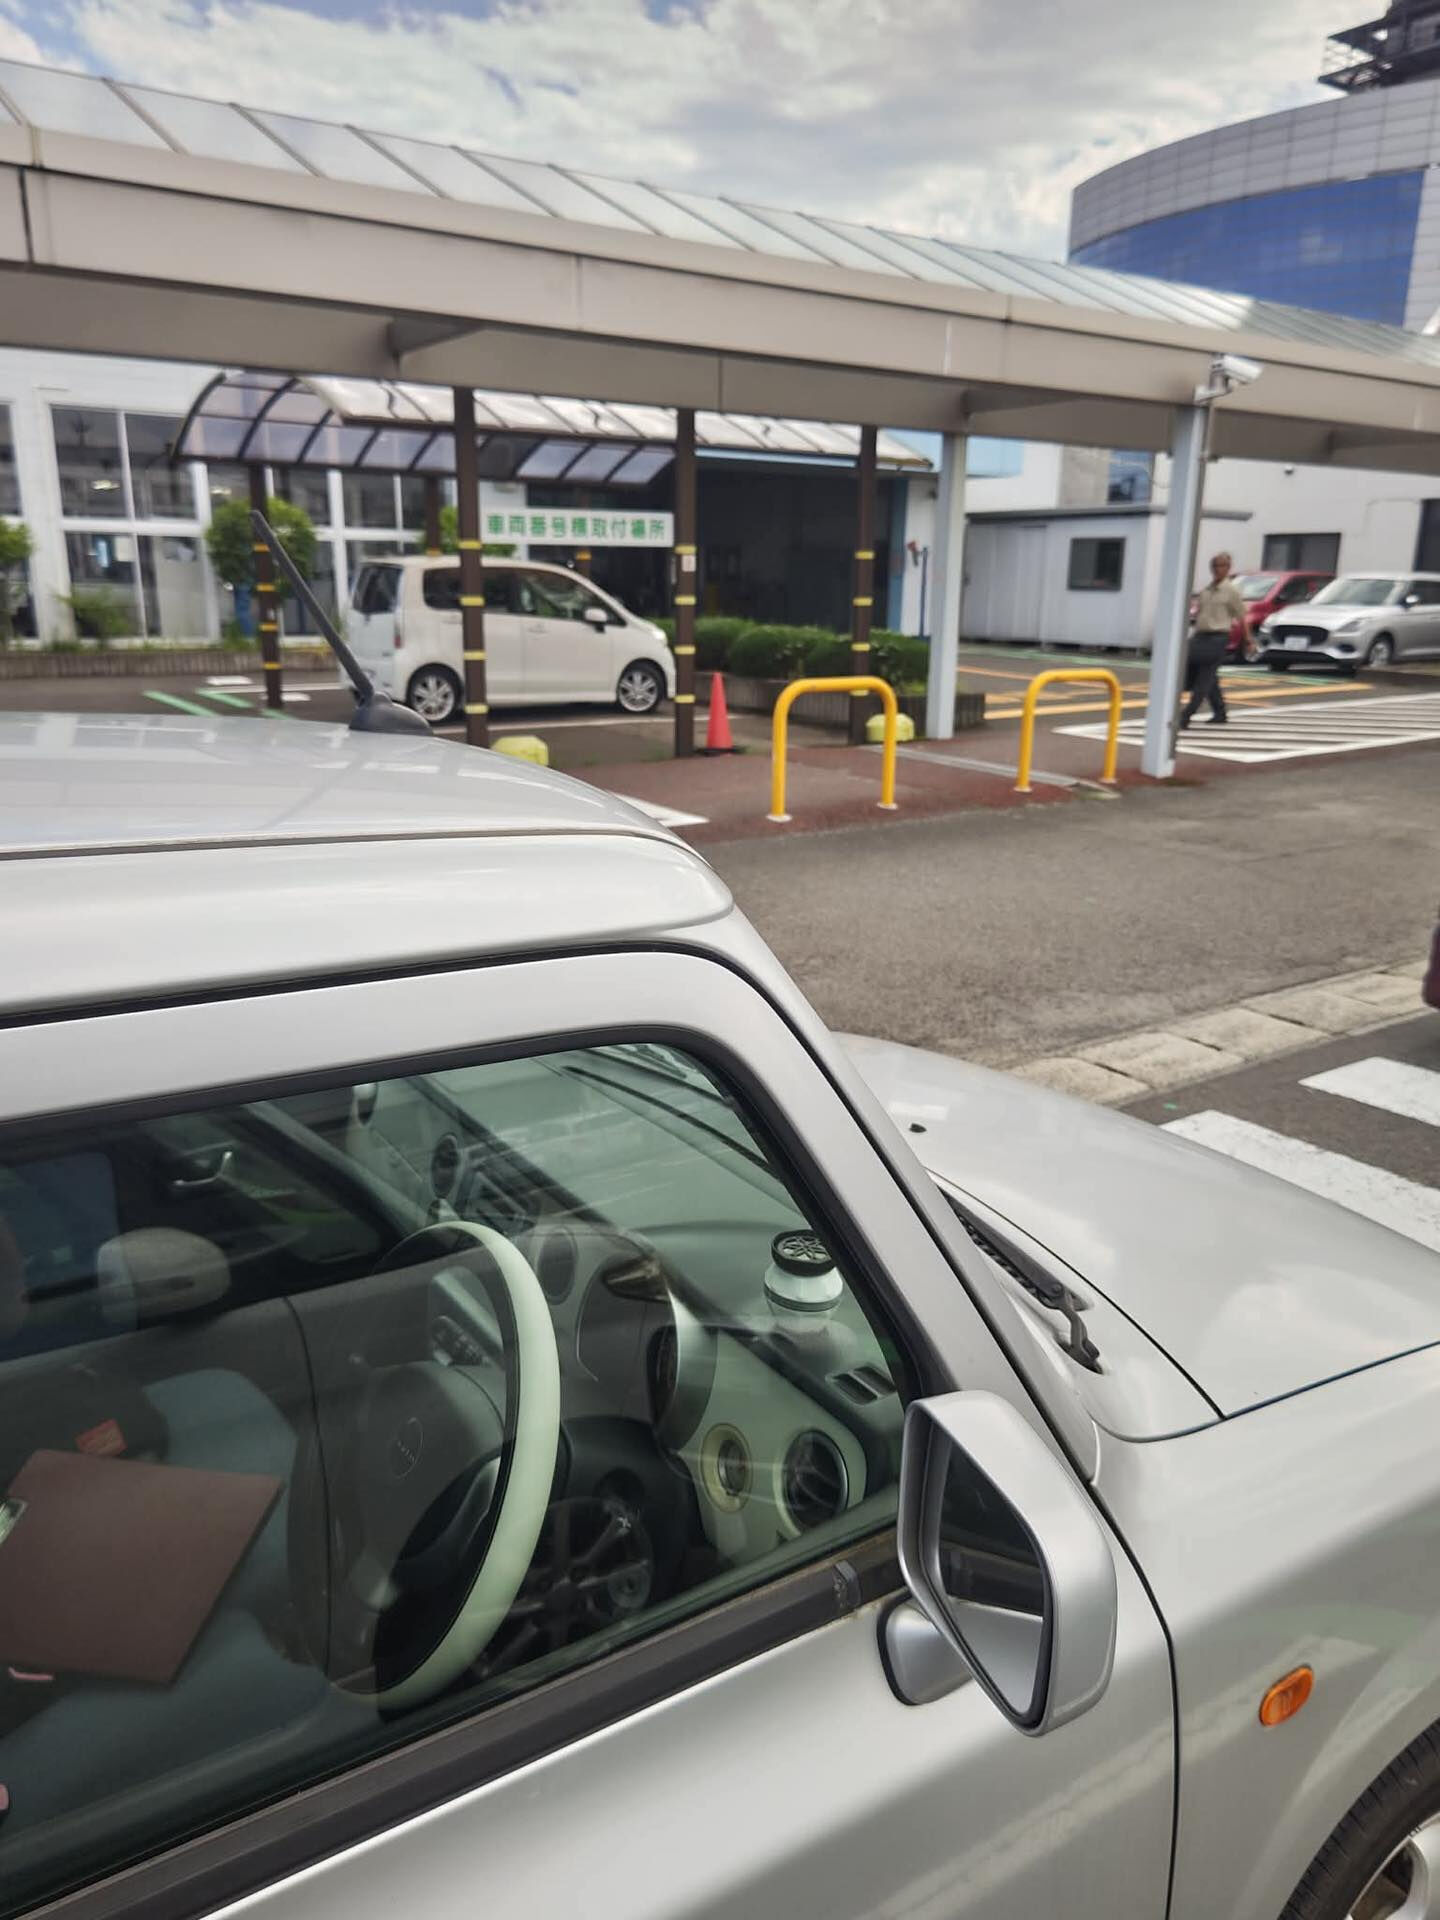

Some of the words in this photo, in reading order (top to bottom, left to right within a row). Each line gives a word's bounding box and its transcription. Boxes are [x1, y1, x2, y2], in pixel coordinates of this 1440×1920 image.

[487, 514, 665, 539] 車両番号標取付場所
